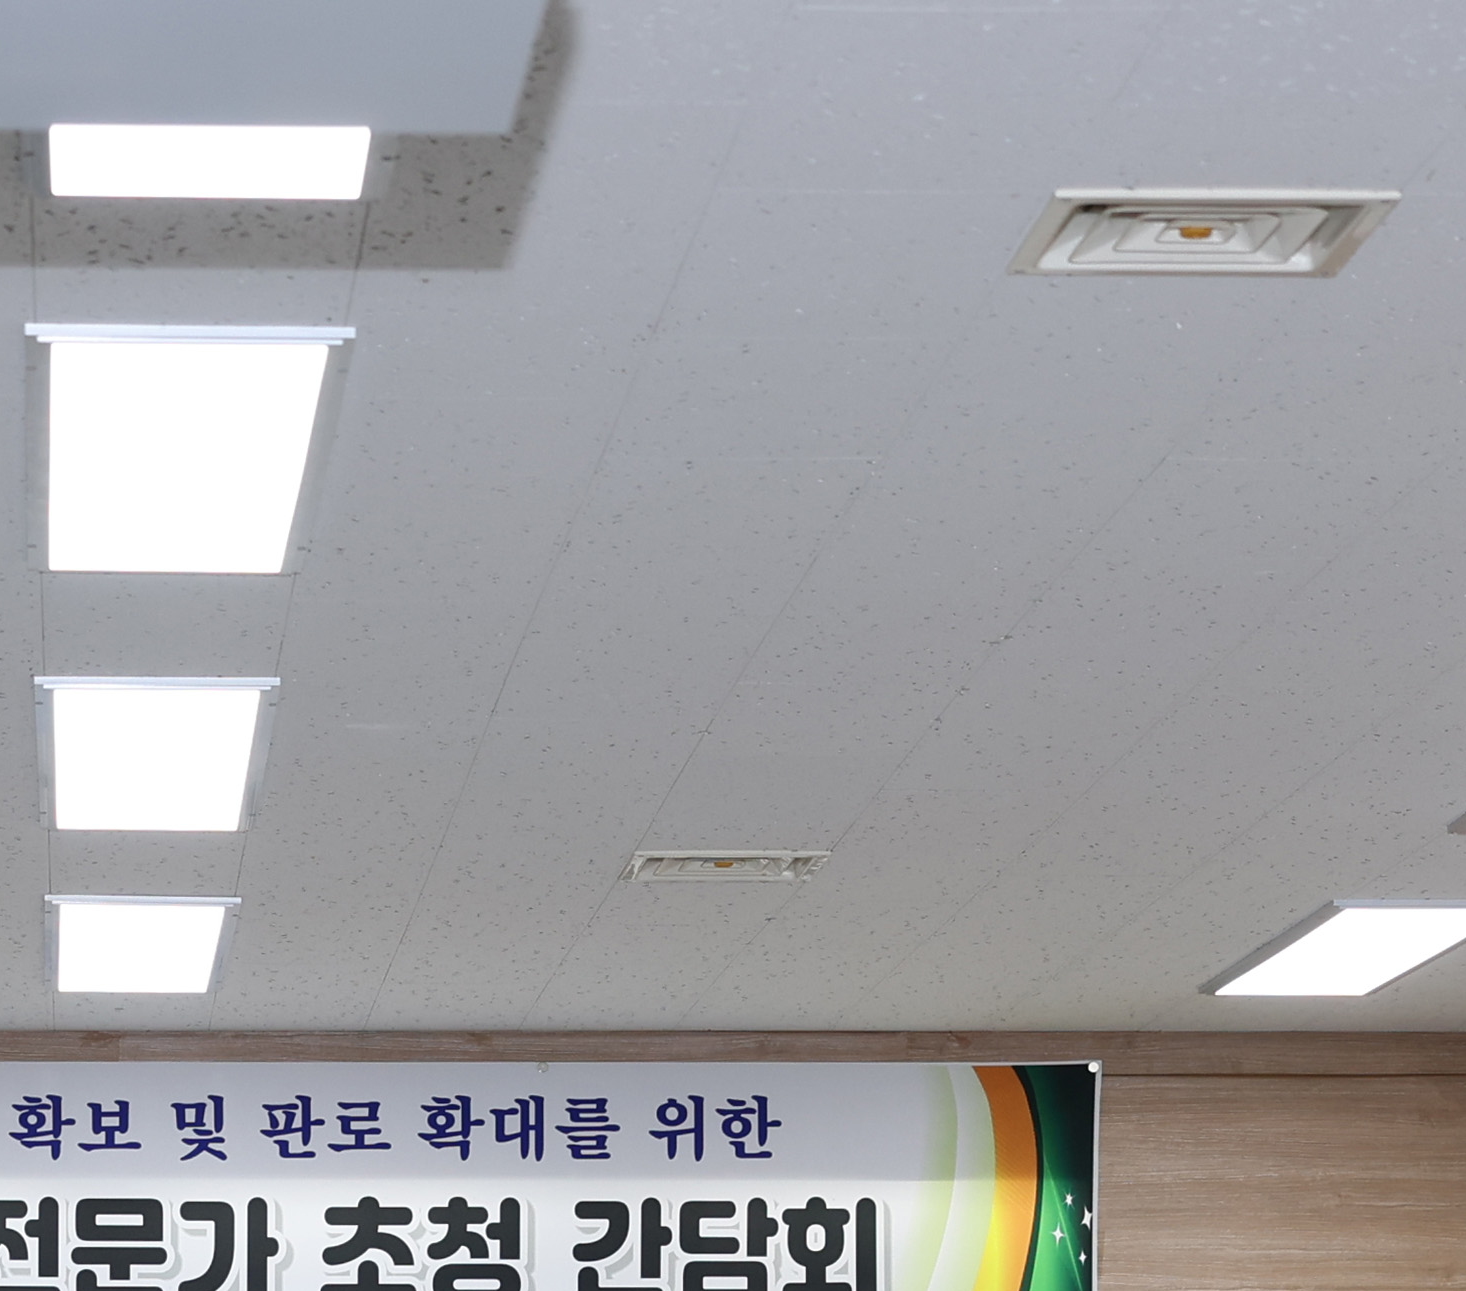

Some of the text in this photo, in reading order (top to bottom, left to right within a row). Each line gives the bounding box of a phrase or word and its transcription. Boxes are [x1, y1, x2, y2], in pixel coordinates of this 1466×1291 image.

[9, 1094, 142, 1161] 확보
[171, 1094, 228, 1161] 및
[260, 1094, 392, 1159] 판로
[418, 1094, 621, 1162] 확대를
[649, 1094, 782, 1162] 위한
